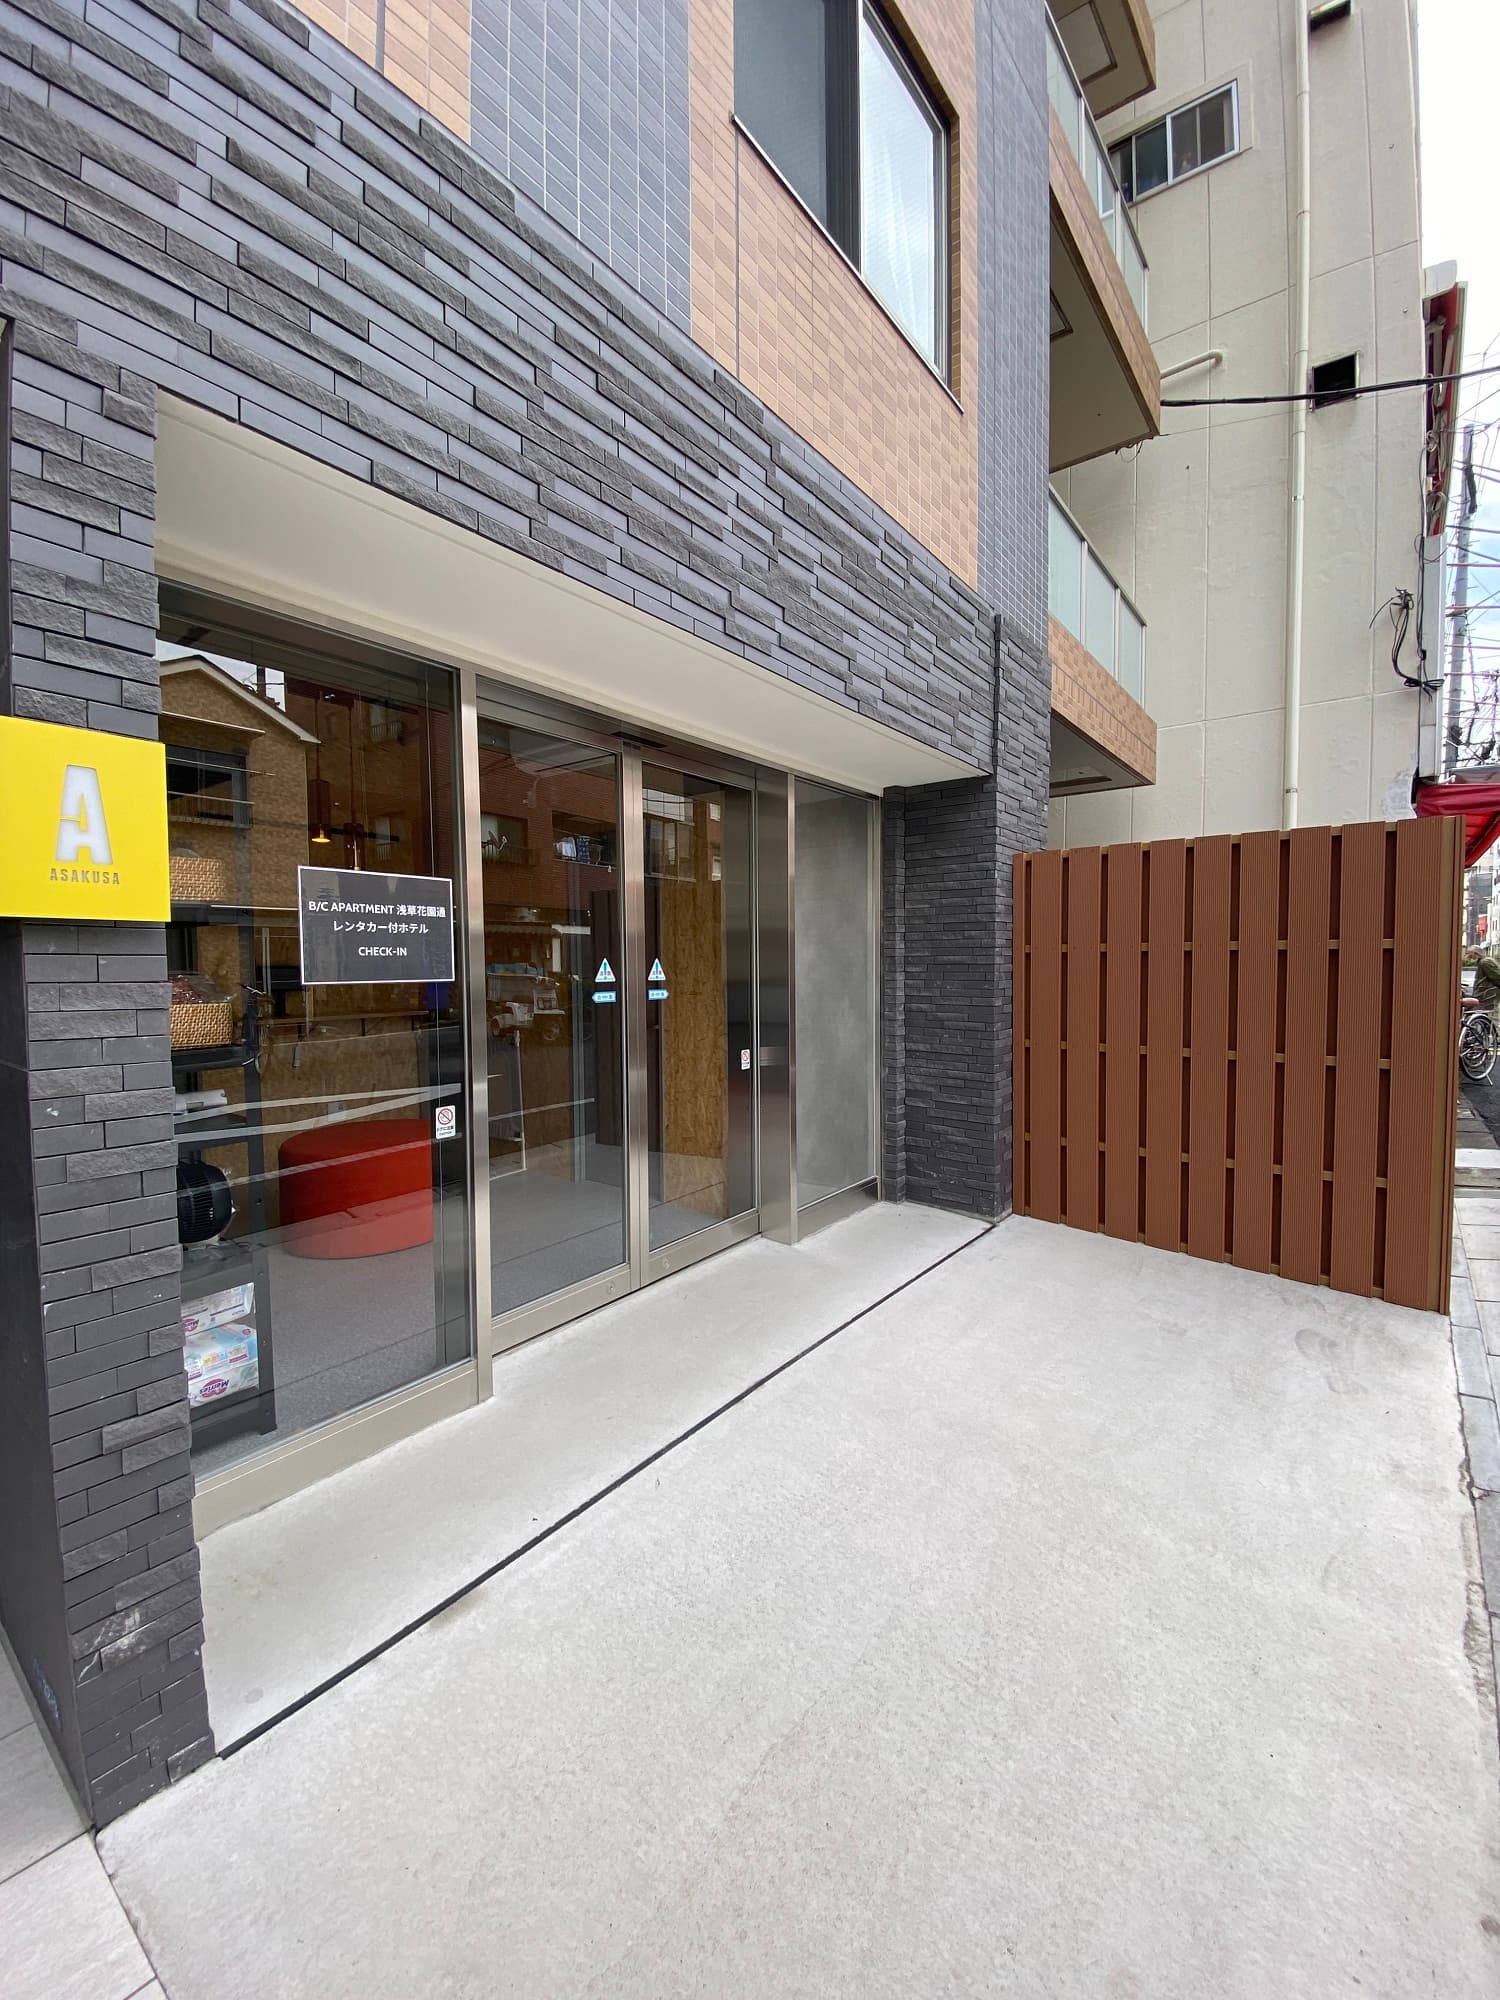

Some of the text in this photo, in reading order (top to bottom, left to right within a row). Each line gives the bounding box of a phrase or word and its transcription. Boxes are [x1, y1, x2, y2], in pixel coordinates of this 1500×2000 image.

[56, 764, 113, 866] A
[50, 867, 120, 885] ASAKUSA
[308, 901, 446, 918] B/C APARTMENT 浅草花園通
[333, 920, 429, 934] レンタカー付ホテル
[358, 947, 407, 957] CHECK-IN
[199, 1379, 230, 1395] Merries
